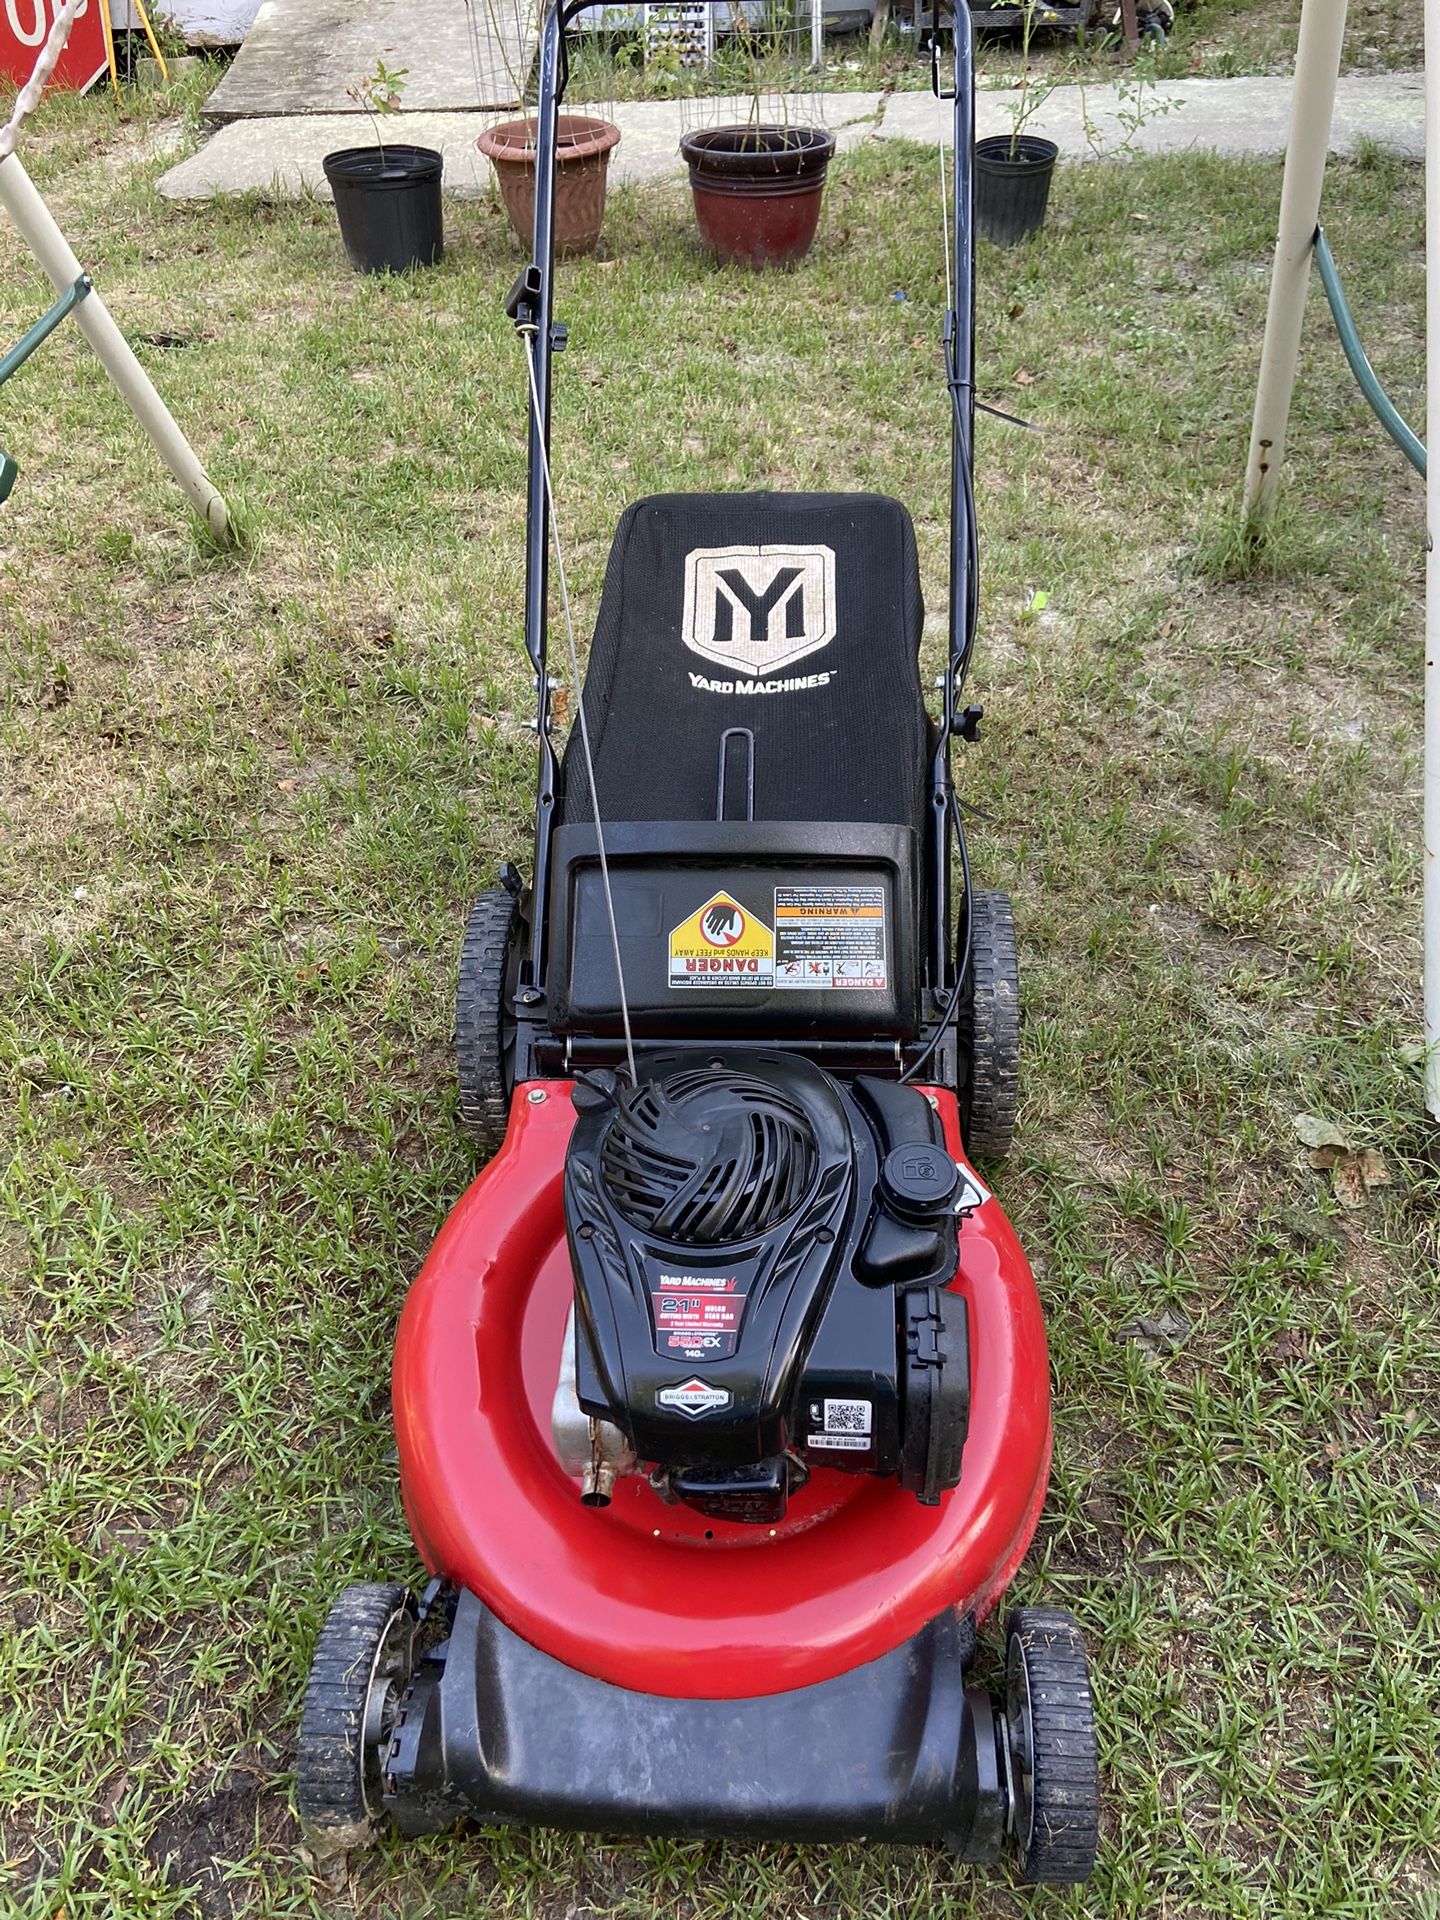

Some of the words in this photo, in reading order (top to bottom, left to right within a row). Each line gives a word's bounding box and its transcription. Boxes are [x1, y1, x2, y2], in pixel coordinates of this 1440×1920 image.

[688, 672, 734, 694] YARD
[685, 959, 758, 972] DANGER
[660, 1275, 681, 1284] YARD
[682, 1276, 726, 1286] MACHINES
[662, 1298, 700, 1312] 21"
